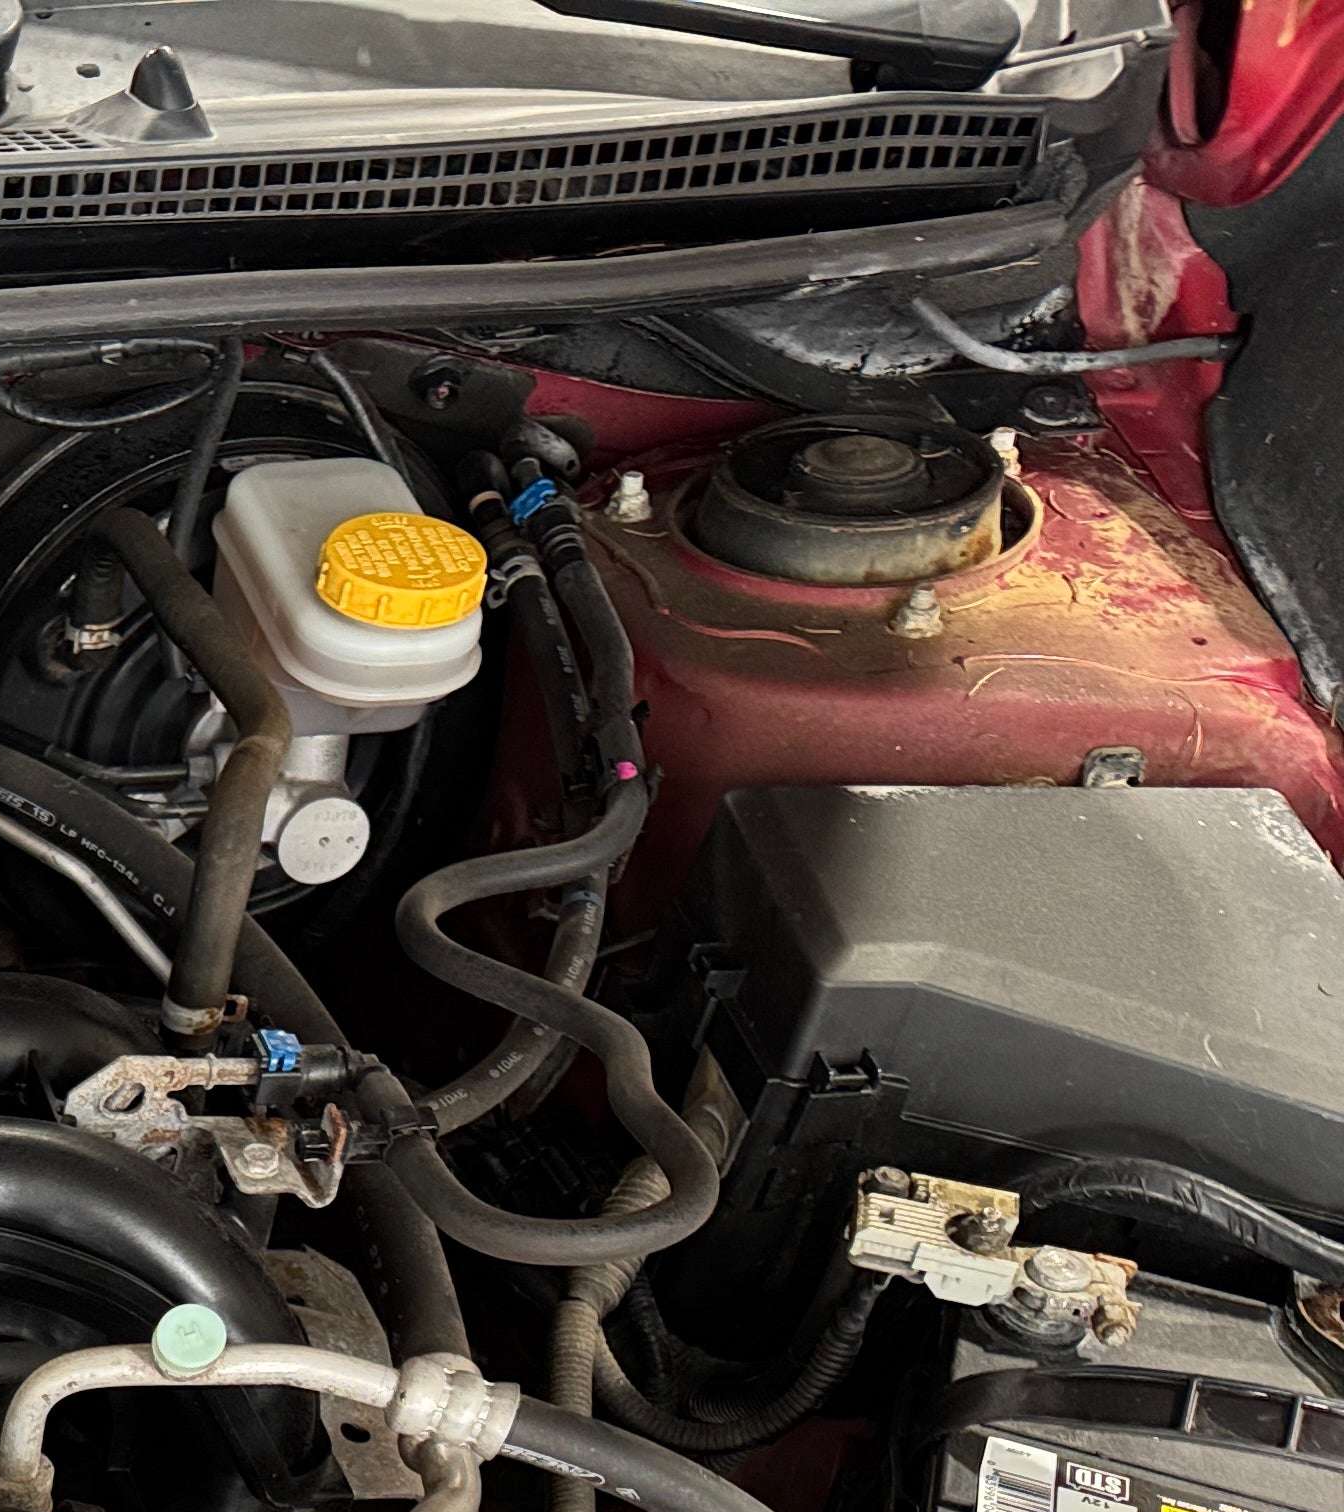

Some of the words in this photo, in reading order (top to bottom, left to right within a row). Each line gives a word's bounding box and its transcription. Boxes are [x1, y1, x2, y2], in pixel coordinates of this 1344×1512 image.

[152, 893, 176, 917] CJ
[1075, 1468, 1122, 1495] STD
[1081, 1496, 1111, 1509] 12V
